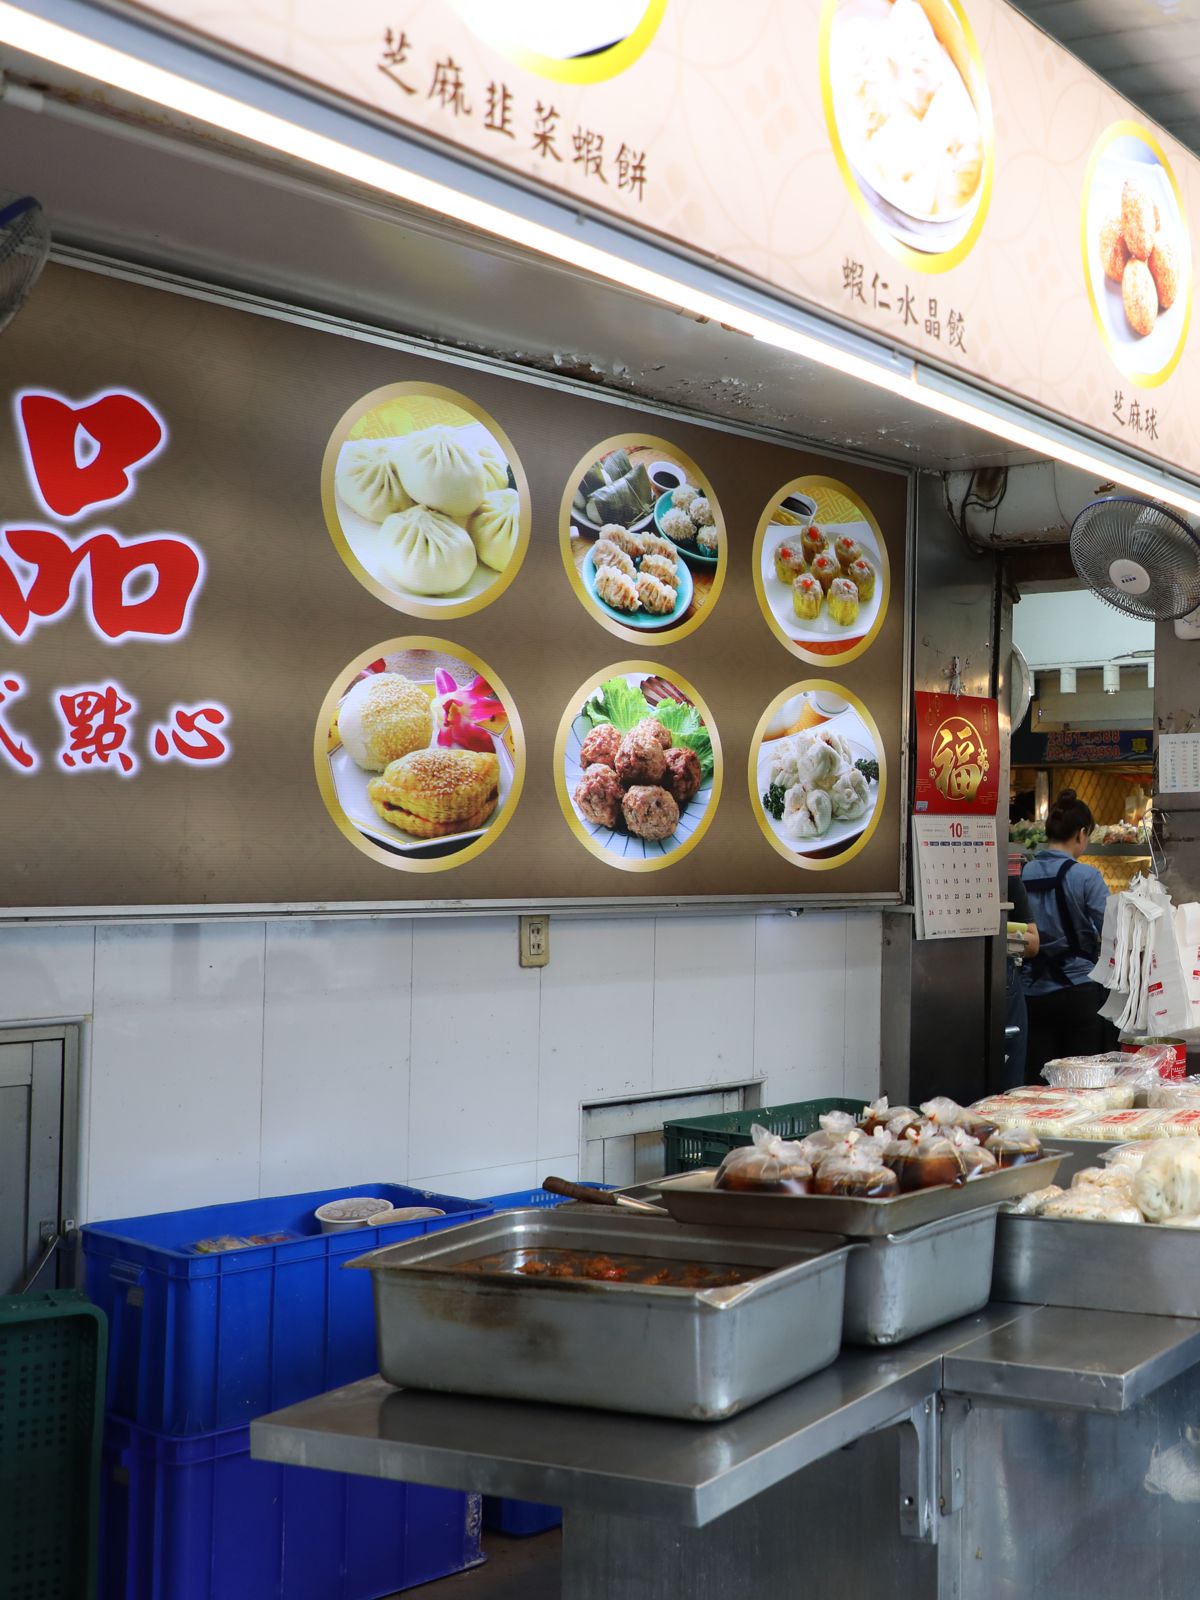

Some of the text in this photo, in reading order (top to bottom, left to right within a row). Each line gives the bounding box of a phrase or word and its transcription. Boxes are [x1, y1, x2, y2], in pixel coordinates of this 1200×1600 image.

[377, 28, 647, 202] 芝麻韭菜蝦餅
[842, 256, 967, 354] 蝦仁水晶餃
[1113, 389, 1160, 440] 芝麻球
[931, 726, 982, 801] 福
[949, 822, 963, 838] 10
